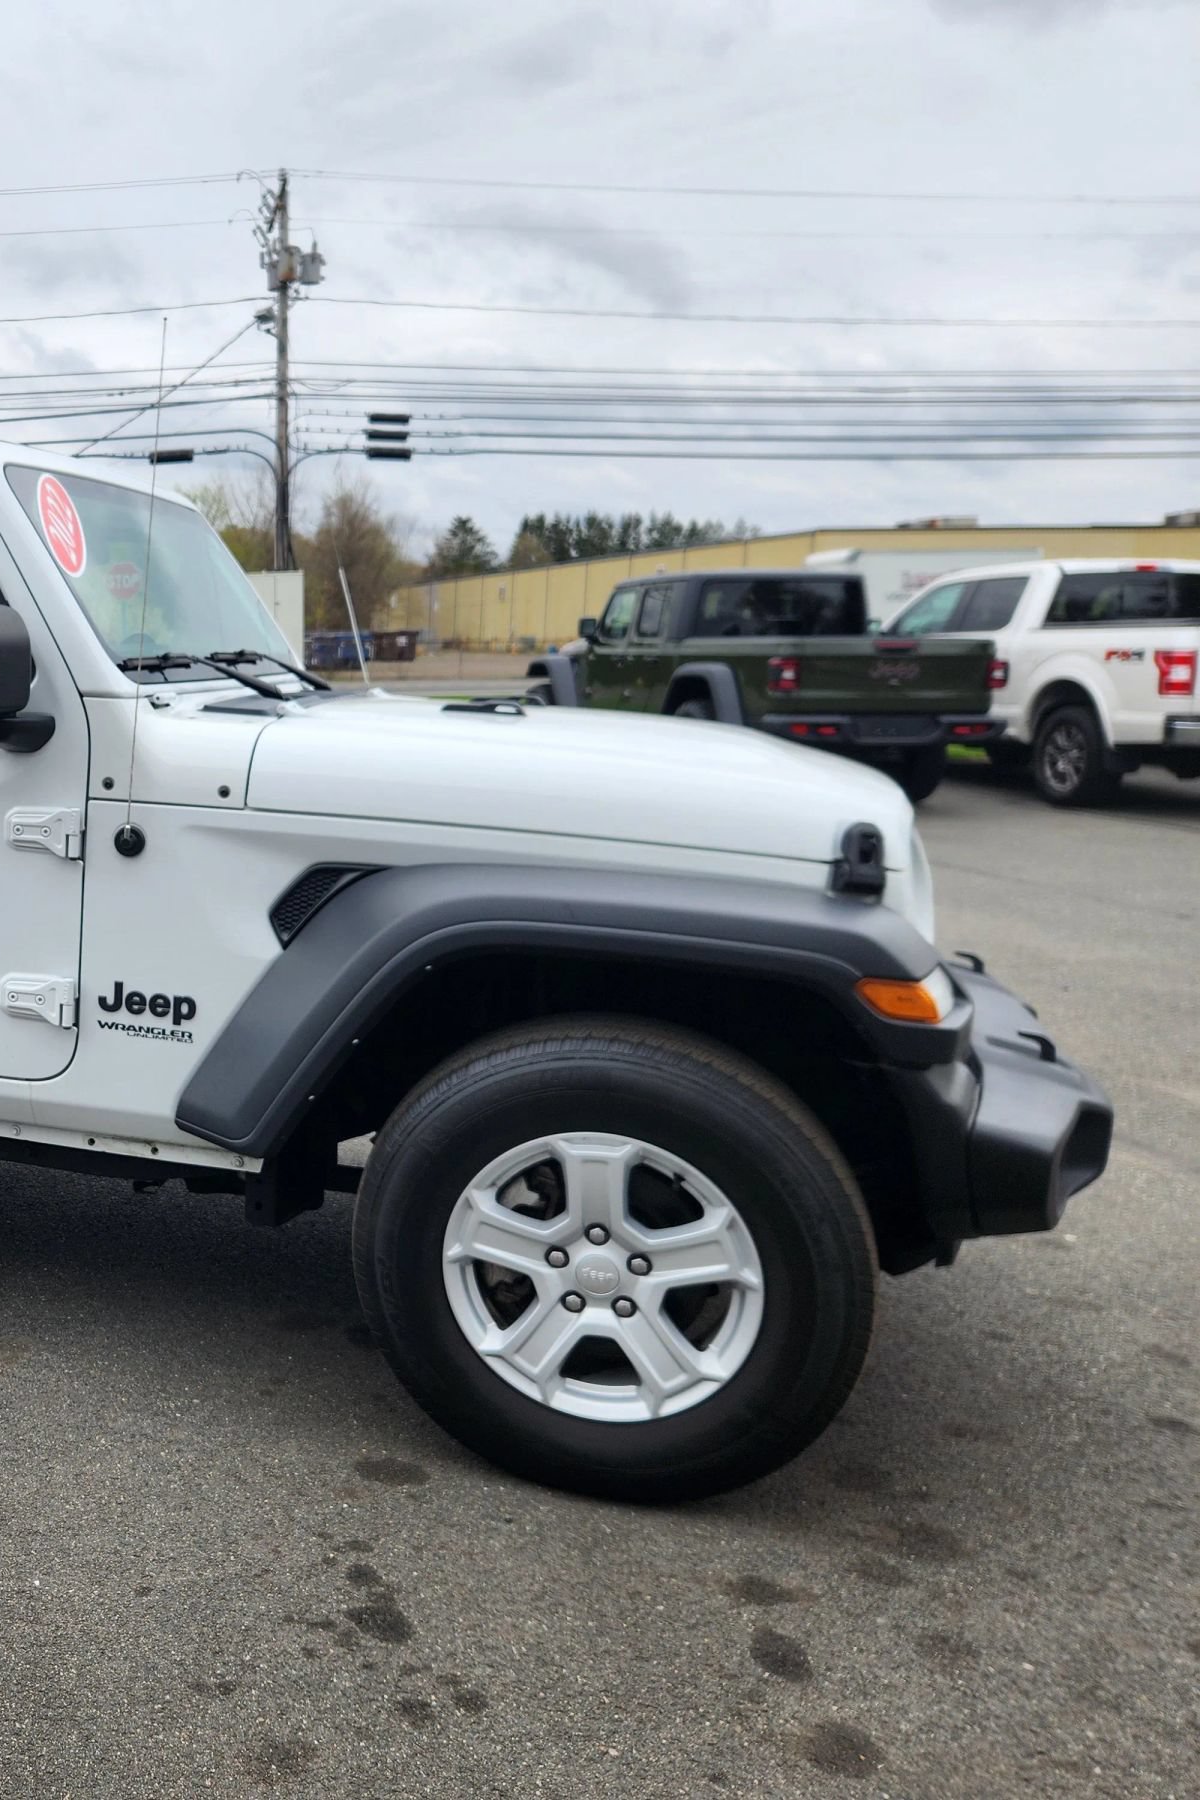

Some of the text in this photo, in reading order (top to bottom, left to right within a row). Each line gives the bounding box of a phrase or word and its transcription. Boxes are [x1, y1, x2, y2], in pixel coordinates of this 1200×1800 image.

[98, 981, 197, 1026] Jeep
[97, 1020, 193, 1040] WRANGLER
[126, 1031, 194, 1044] UNLIMITED
